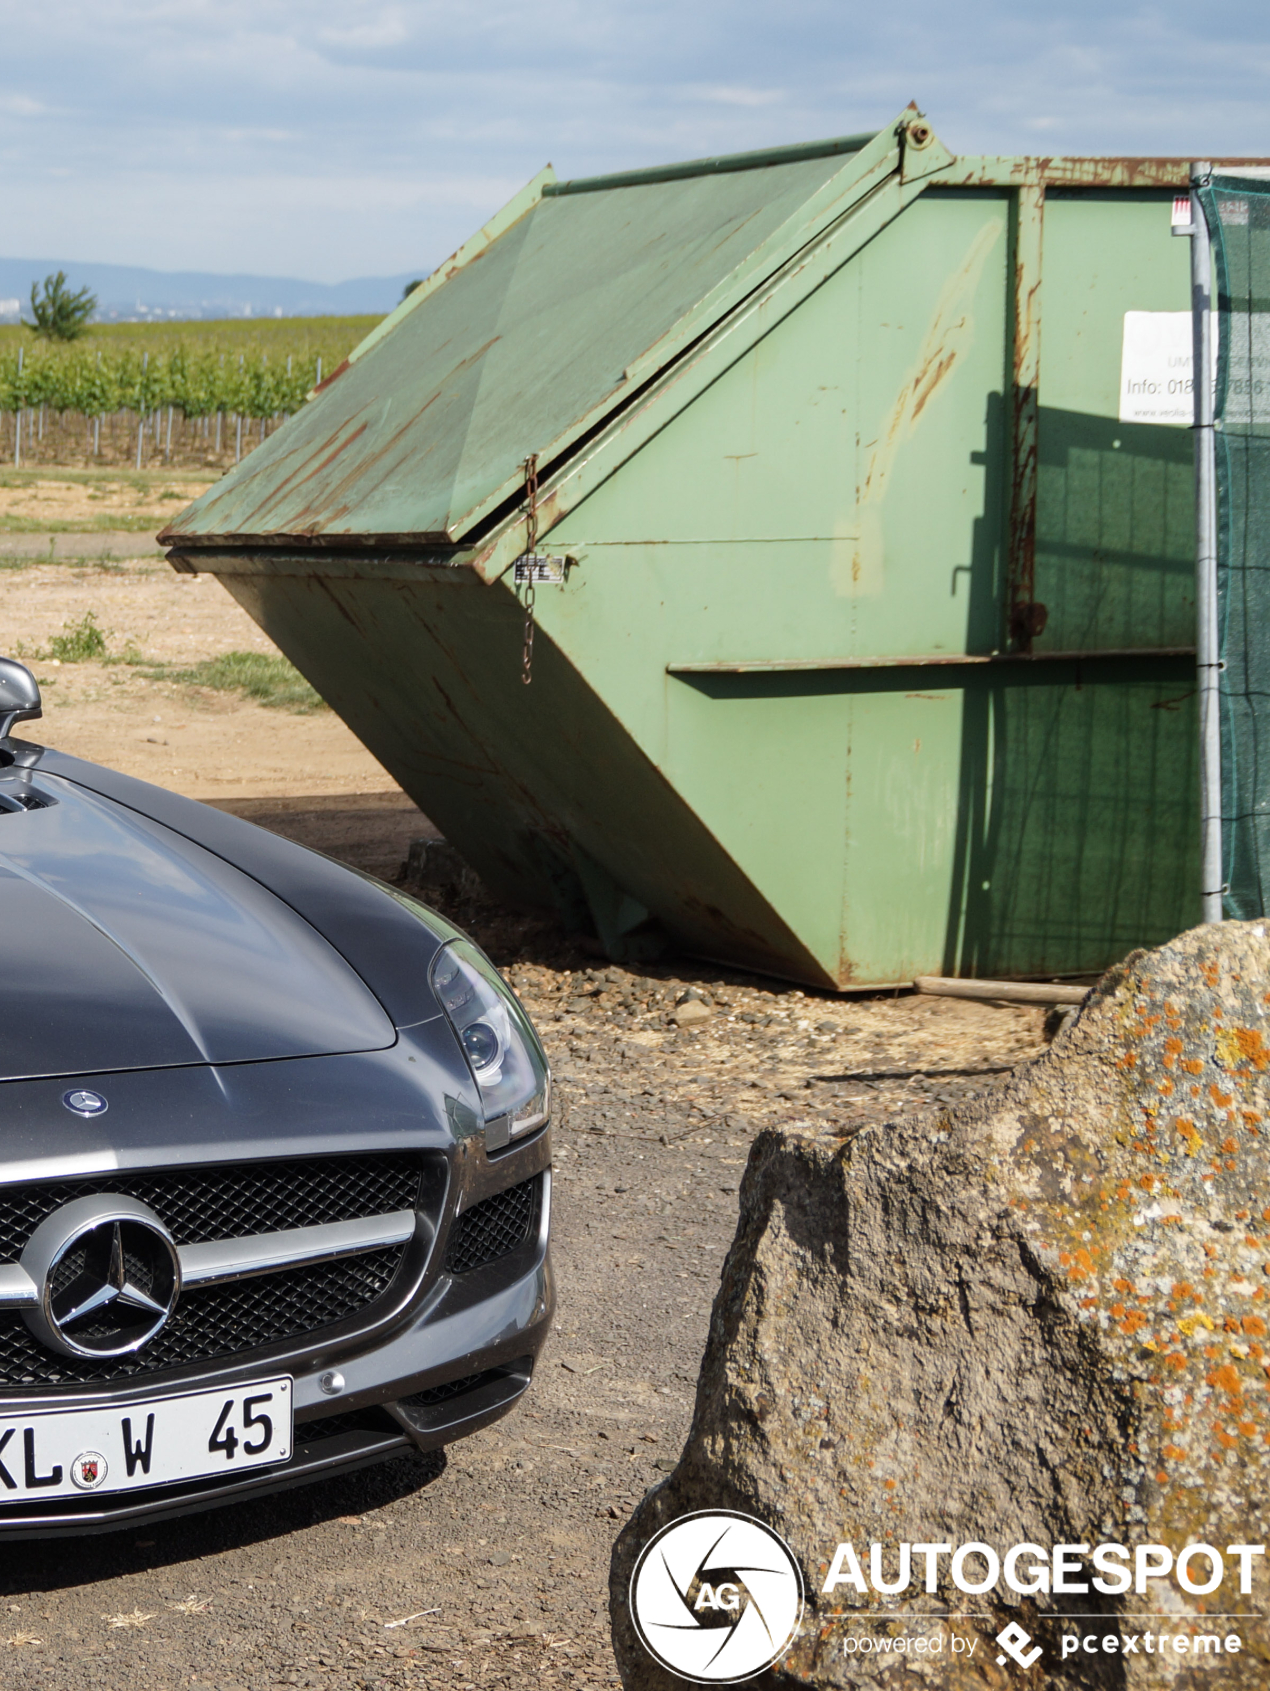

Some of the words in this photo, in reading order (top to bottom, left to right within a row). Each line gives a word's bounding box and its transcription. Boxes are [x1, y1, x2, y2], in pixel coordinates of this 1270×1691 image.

[1126, 378, 1162, 395] Info:
[121, 1413, 155, 1478] W
[207, 1392, 274, 1460] 45
